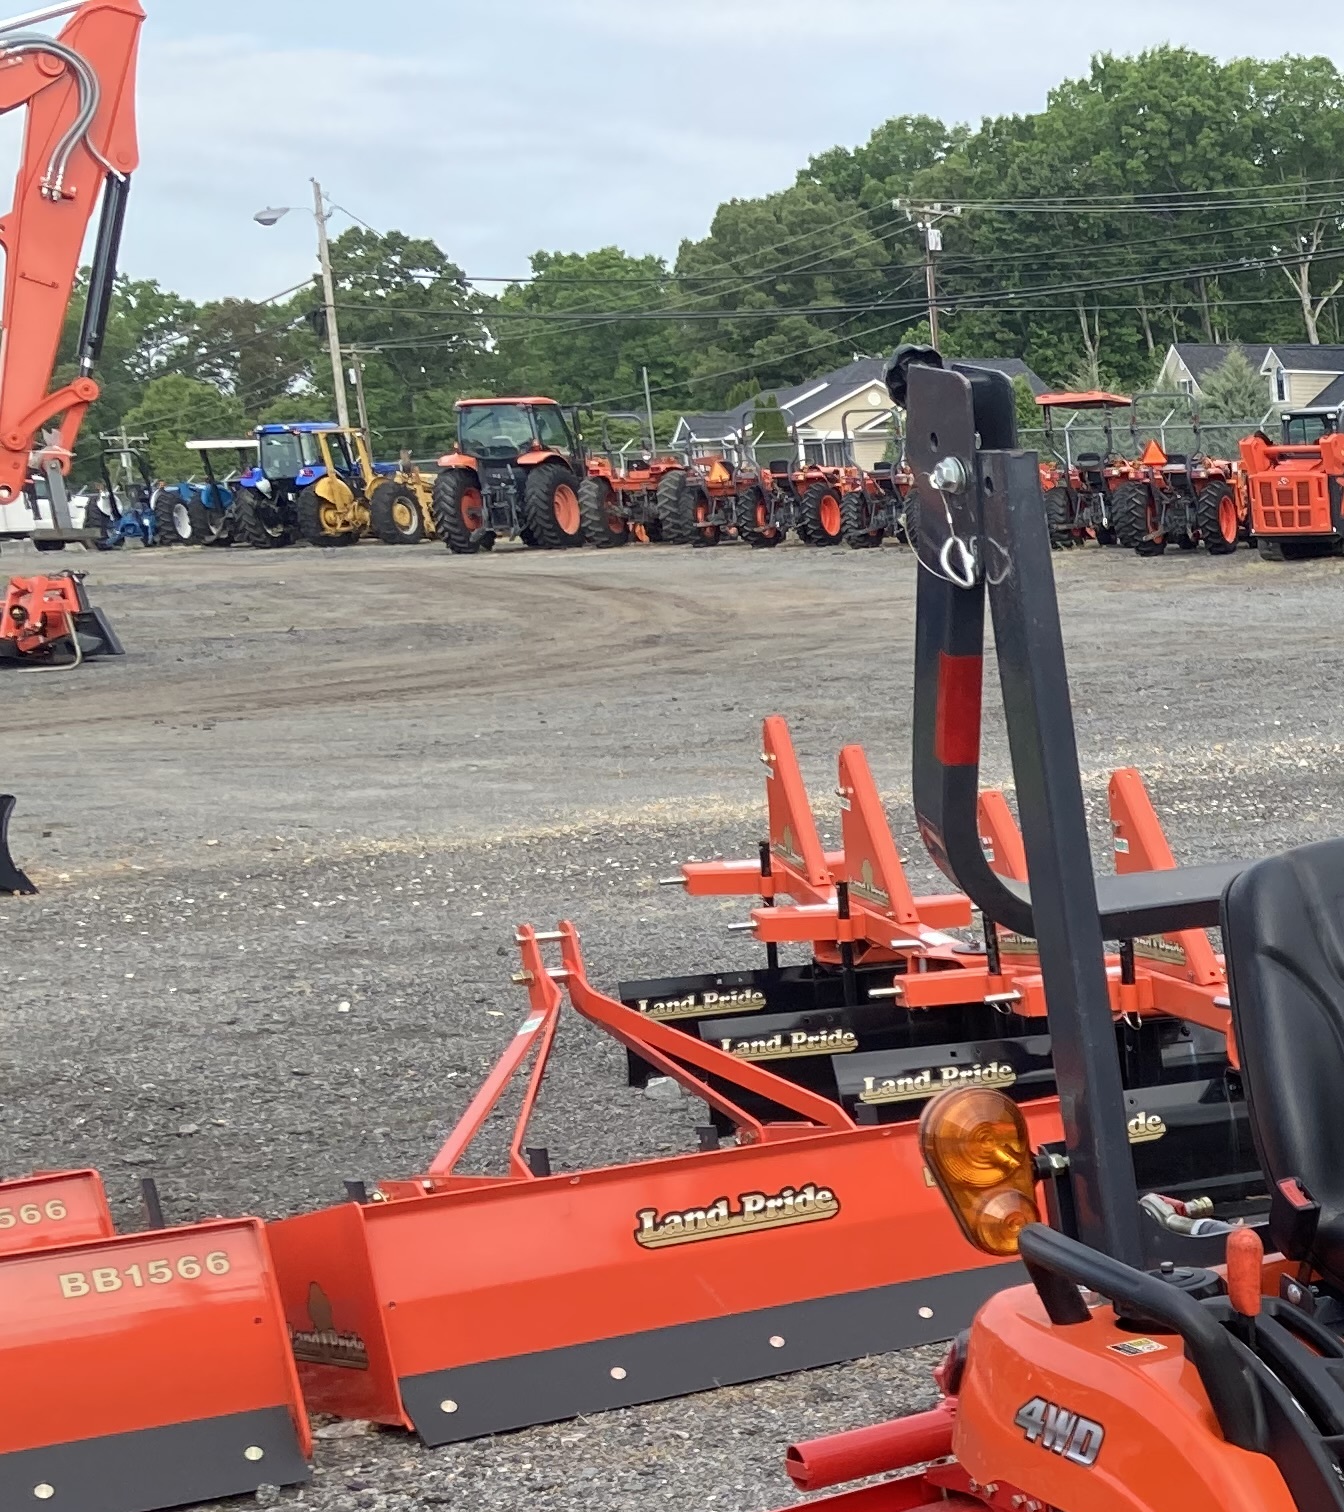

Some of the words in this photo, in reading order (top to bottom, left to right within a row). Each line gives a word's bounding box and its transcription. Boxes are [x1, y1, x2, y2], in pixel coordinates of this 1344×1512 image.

[638, 994, 696, 1016] Land
[703, 988, 764, 1010] Pride
[720, 1034, 782, 1055] Land
[790, 1029, 857, 1050] Pride
[862, 1070, 932, 1098] Land
[940, 1061, 1014, 1088] Pride
[0, 1199, 68, 1230] 566
[639, 1200, 730, 1239] Land
[741, 1184, 834, 1222] Pride
[59, 1251, 231, 1299] BB1566
[1014, 1395, 1106, 1468] 4WD
